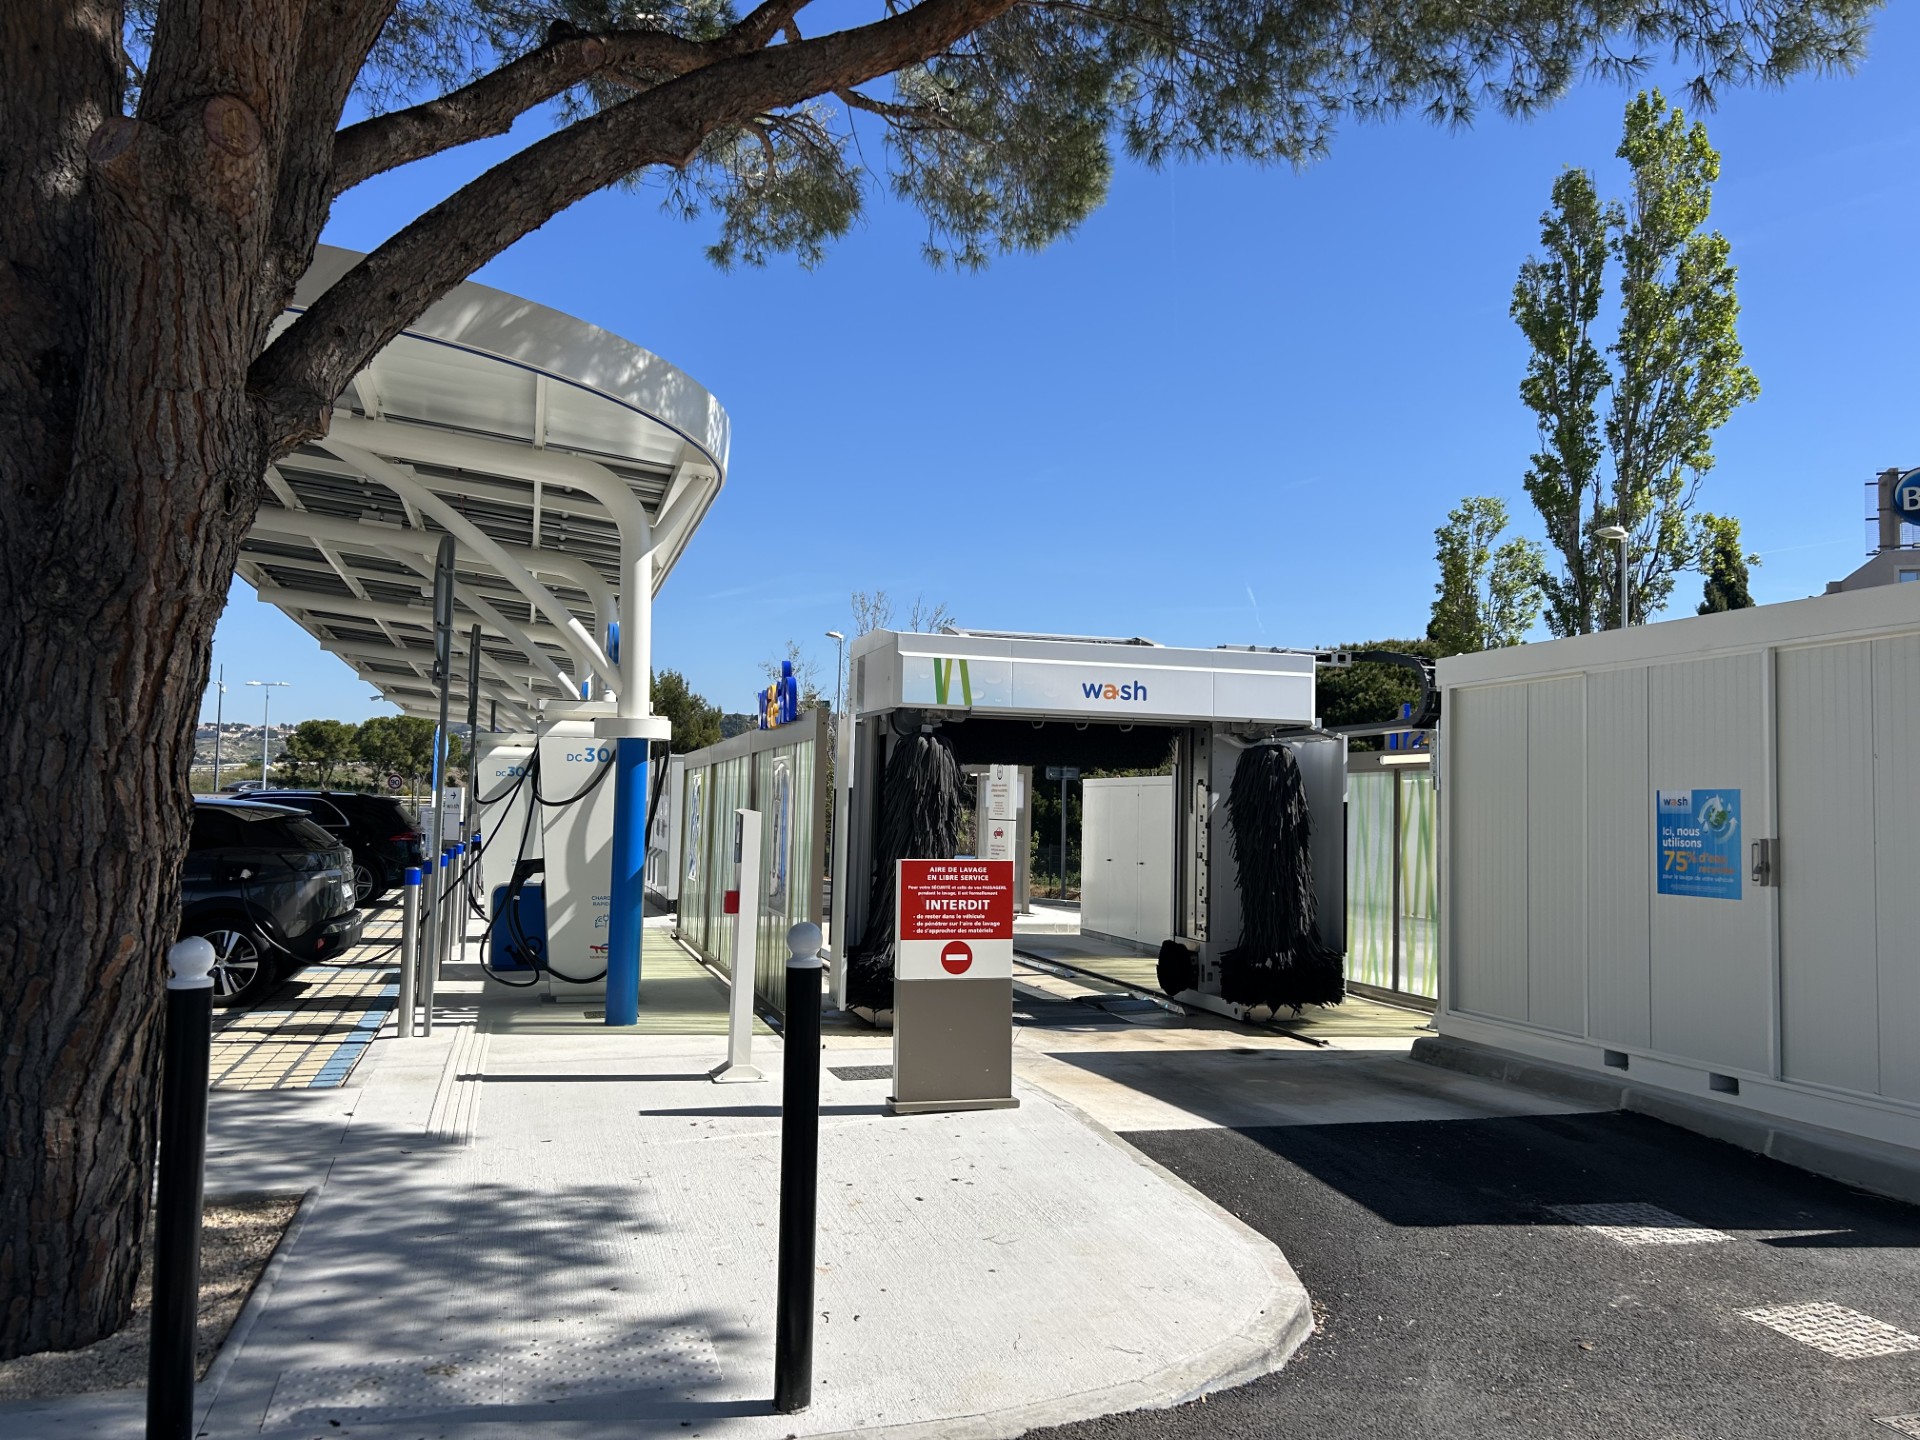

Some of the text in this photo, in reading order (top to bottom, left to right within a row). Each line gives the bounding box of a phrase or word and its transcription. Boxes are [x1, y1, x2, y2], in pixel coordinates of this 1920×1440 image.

[1082, 680, 1148, 701] wash
[566, 753, 583, 762] DC
[1663, 796, 1689, 807] wash
[1662, 826, 1700, 837] Ici, nous
[1662, 837, 1702, 848] utilisons
[925, 899, 990, 910] INTERDIT
